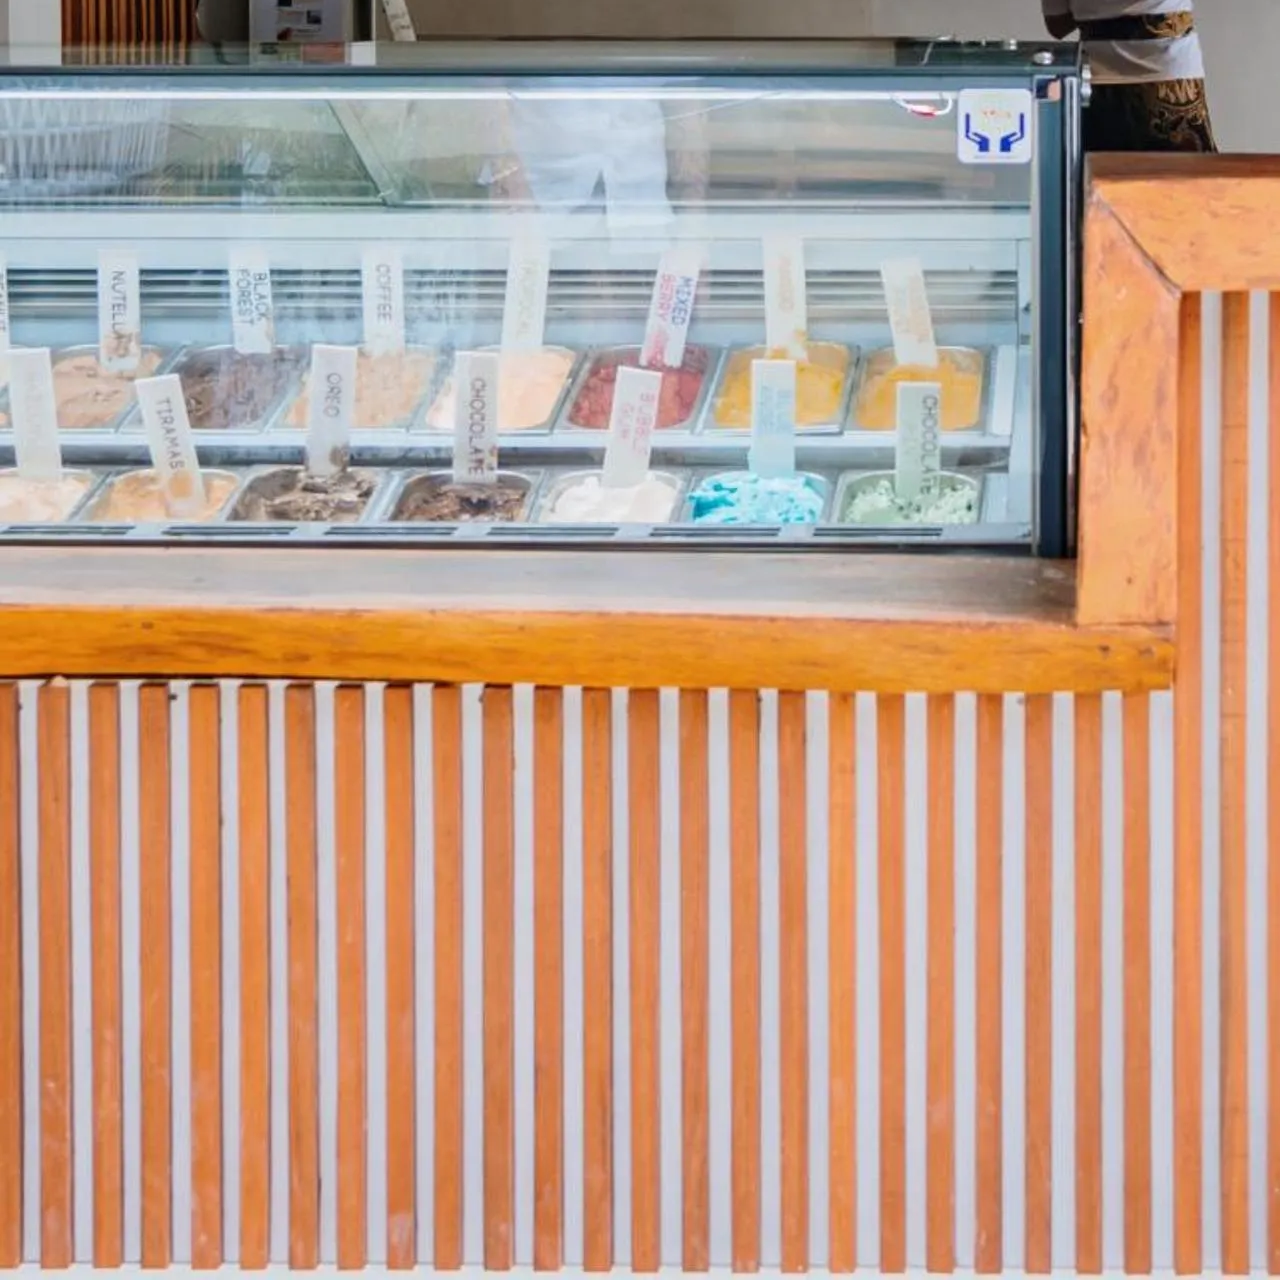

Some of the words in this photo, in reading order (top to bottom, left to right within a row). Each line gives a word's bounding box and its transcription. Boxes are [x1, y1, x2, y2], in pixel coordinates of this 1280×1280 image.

[236, 269, 254, 325] FOREST
[253, 272, 270, 322] BLACK
[375, 264, 393, 322] COFFEE
[656, 273, 674, 322] BERRY
[672, 276, 693, 326] MIXED
[324, 372, 343, 418] OREO
[155, 397, 187, 472] TIRAMAS
[469, 377, 487, 475] CHOCOLATE
[920, 395, 939, 495] CHOCOLATE
